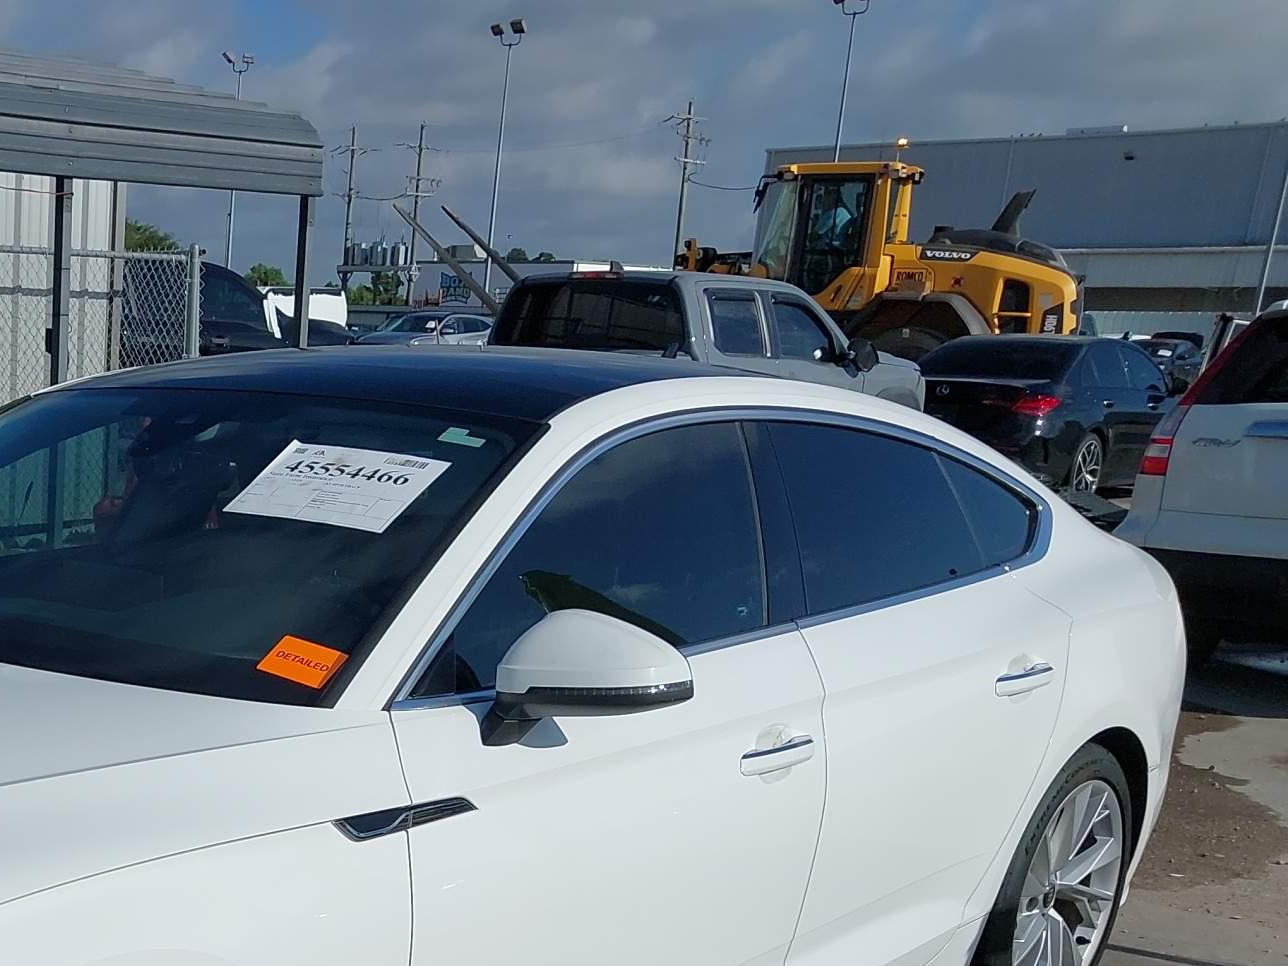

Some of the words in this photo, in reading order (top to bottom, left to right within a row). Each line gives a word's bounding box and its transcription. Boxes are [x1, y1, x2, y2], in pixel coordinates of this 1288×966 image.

[925, 250, 971, 259] VOLVO
[285, 460, 415, 486] 45554466
[275, 650, 330, 672] DETAILED
